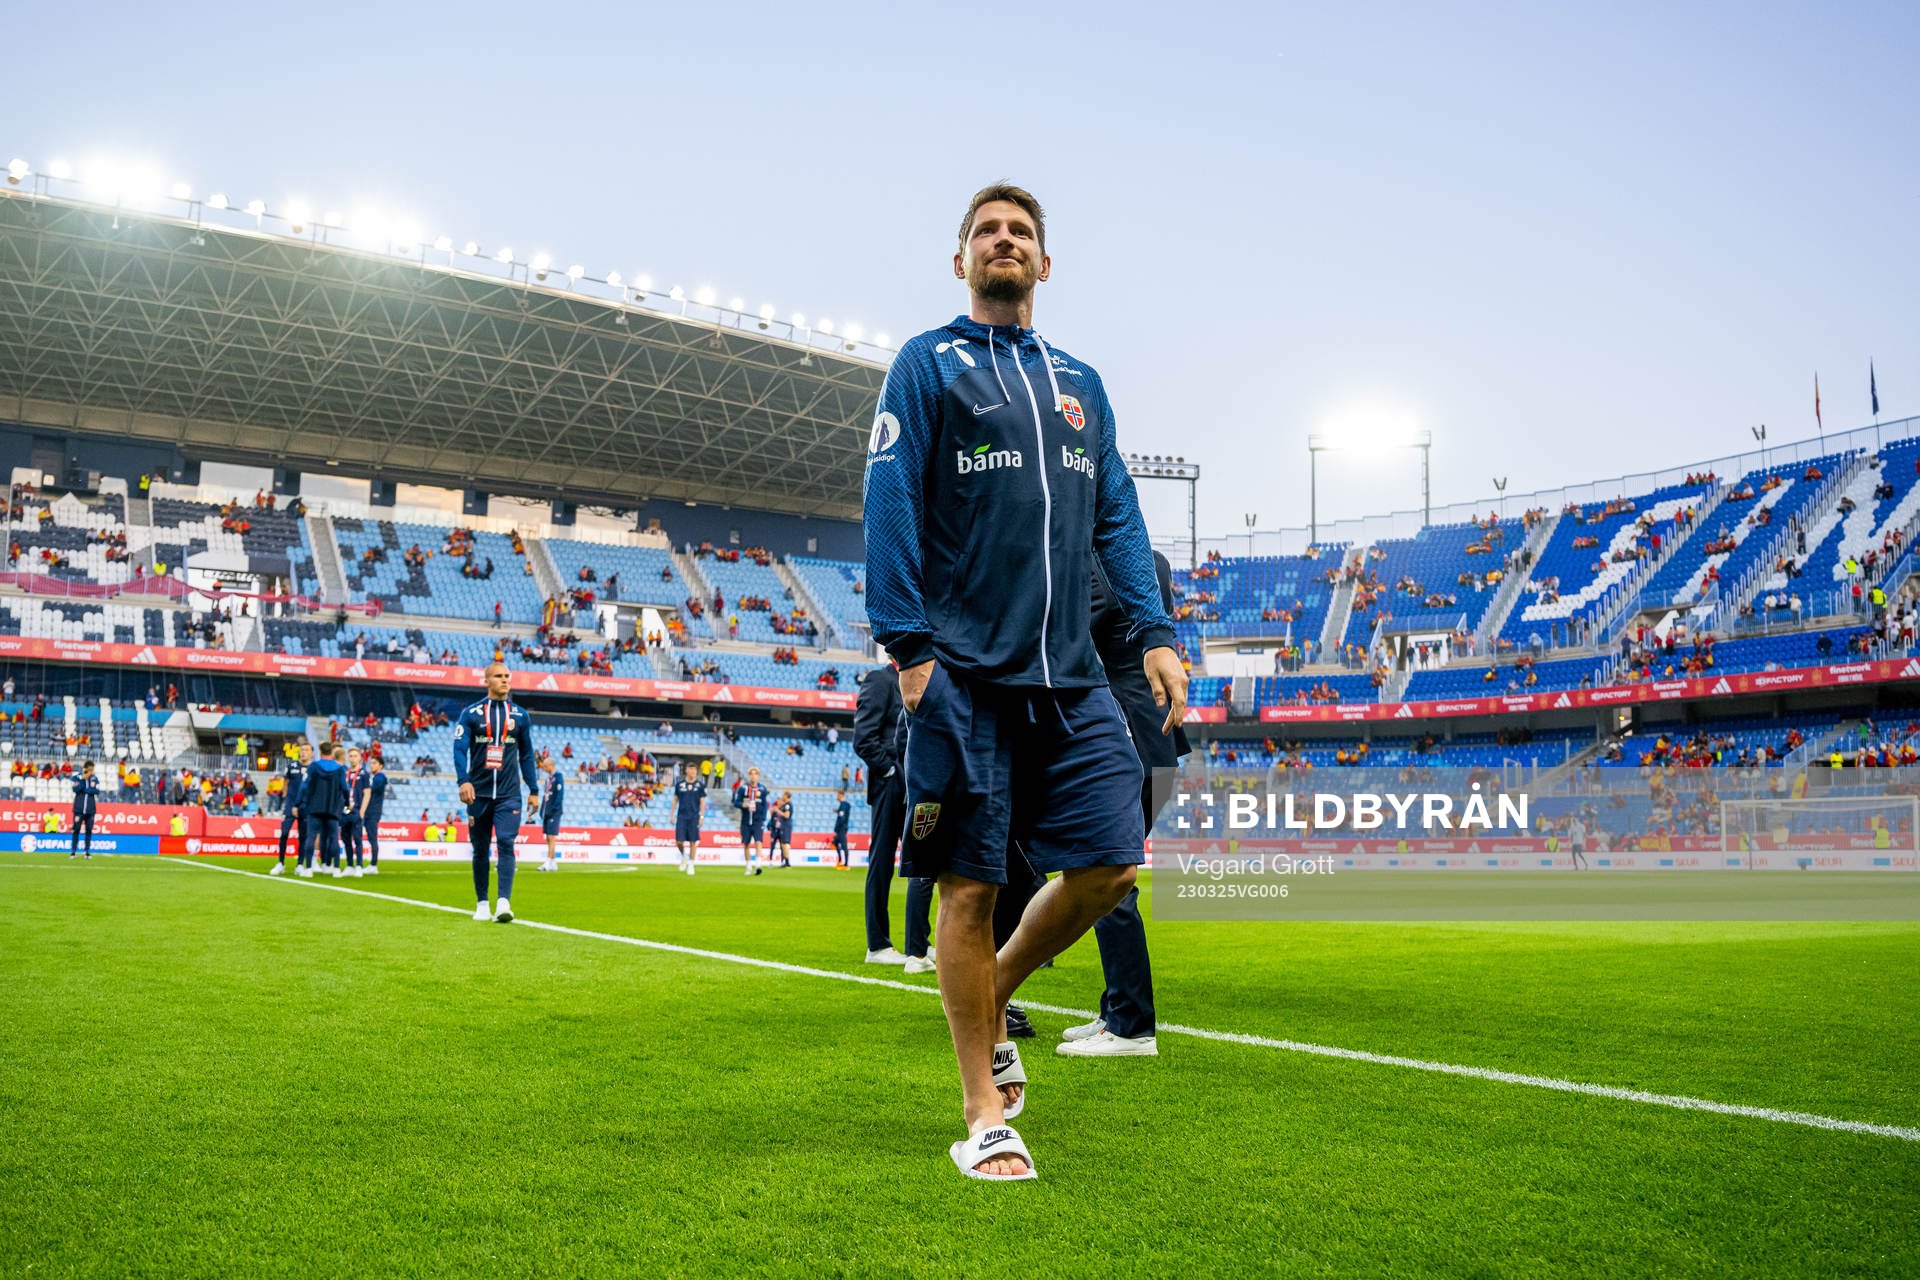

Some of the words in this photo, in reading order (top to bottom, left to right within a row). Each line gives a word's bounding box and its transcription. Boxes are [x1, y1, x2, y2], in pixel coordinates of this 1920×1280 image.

[957, 449, 1023, 474] bama
[94, 812, 158, 824] PAÑOLA
[18, 823, 40, 833] DE
[202, 843, 247, 853] EUROPEAN
[421, 848, 447, 856] SEUR
[1814, 857, 1842, 866] SEUR
[993, 1049, 1014, 1065] NIKE
[983, 1129, 1012, 1143] NIKE
